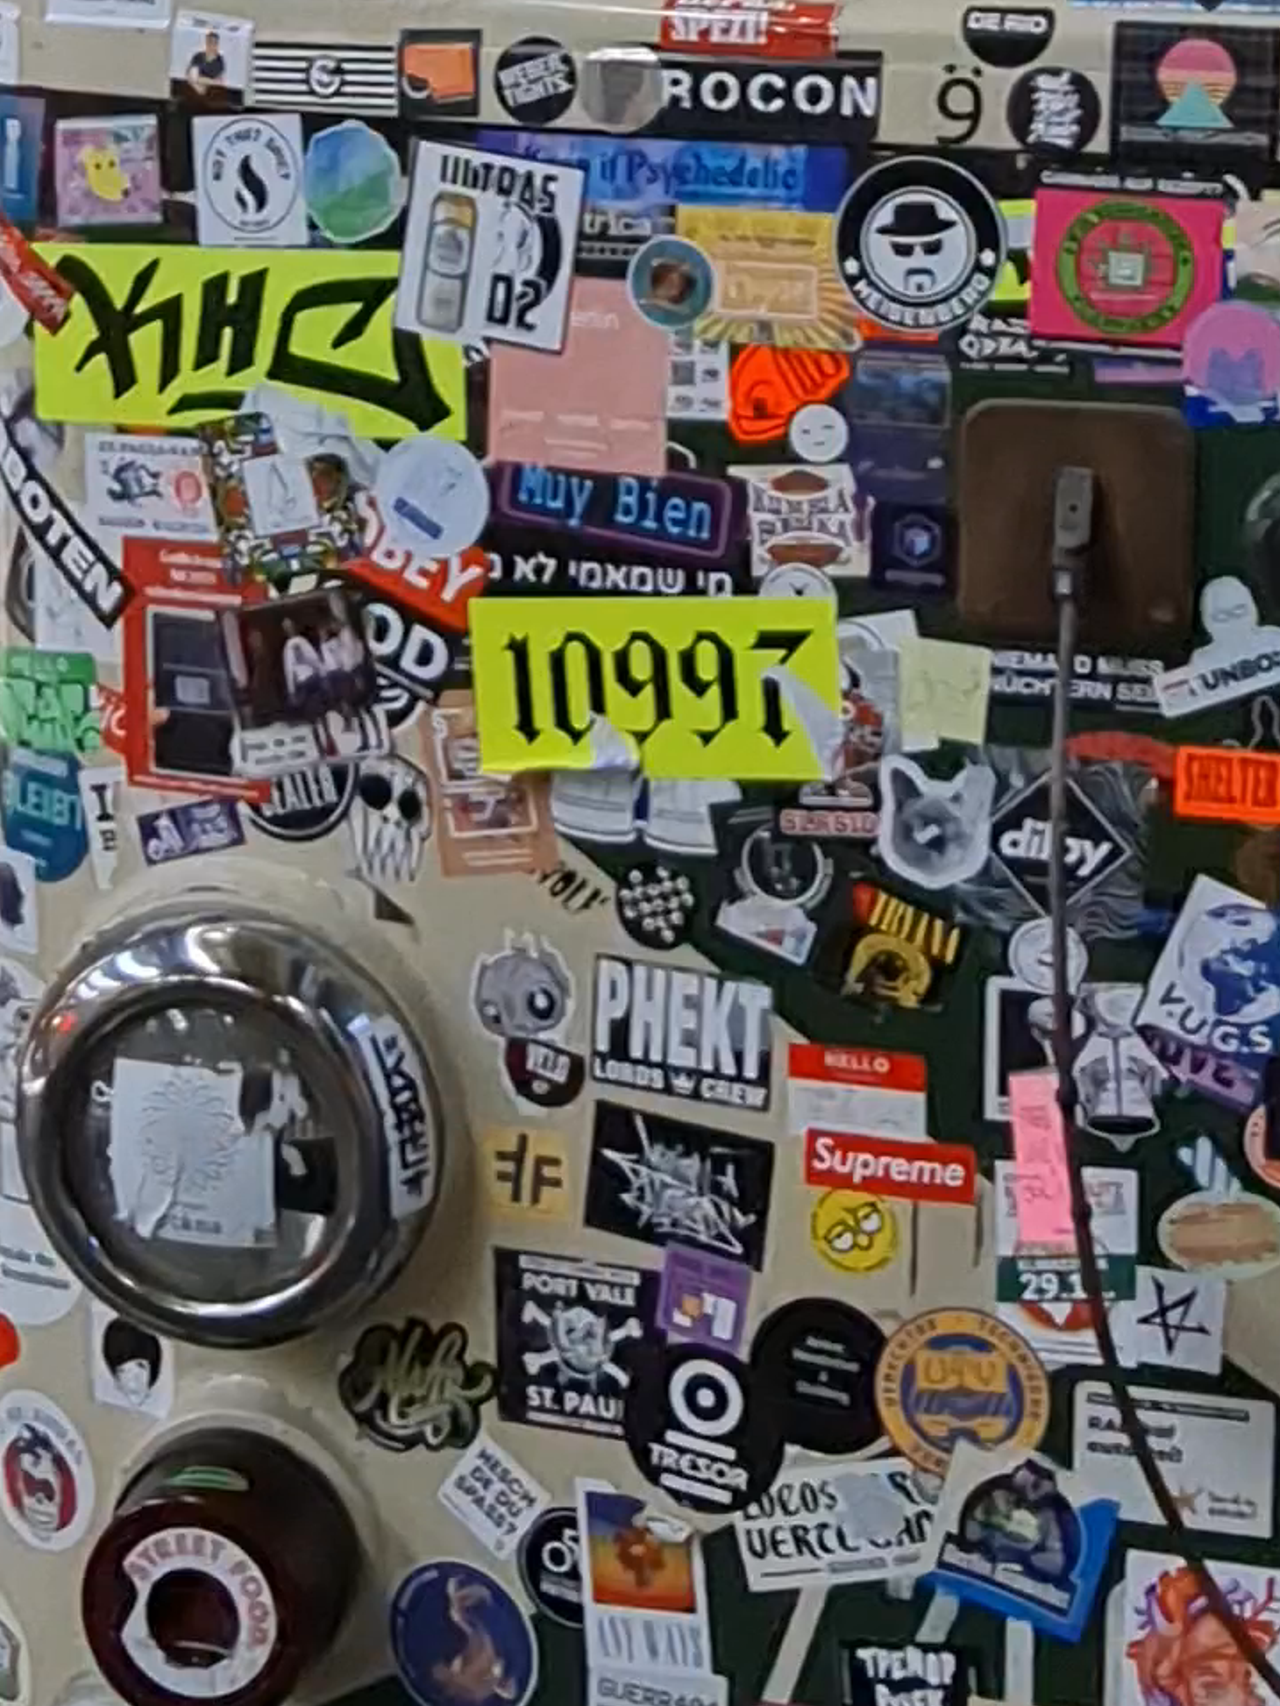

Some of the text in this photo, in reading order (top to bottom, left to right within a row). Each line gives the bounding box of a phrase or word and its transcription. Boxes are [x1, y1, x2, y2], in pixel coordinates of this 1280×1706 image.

[661, 71, 878, 117] ROCON
[623, 151, 802, 190] Psychedelic
[851, 270, 994, 326] HEISENBERG
[517, 463, 594, 510] Muy
[612, 479, 713, 541] Bien
[993, 649, 1091, 675] NIEMAD
[503, 630, 815, 749] 10997
[1182, 750, 1280, 808] SHELTER
[595, 956, 773, 1080] PHEKT
[593, 1056, 770, 1110] LORDS CREW
[823, 1051, 890, 1074] HELLO
[811, 1136, 968, 1189] Supreme
[521, 1271, 582, 1297] PORT
[525, 1385, 560, 1411] ST.
[648, 1442, 748, 1491] TRESOR
[122, 1532, 272, 1649] STREET FOOD
